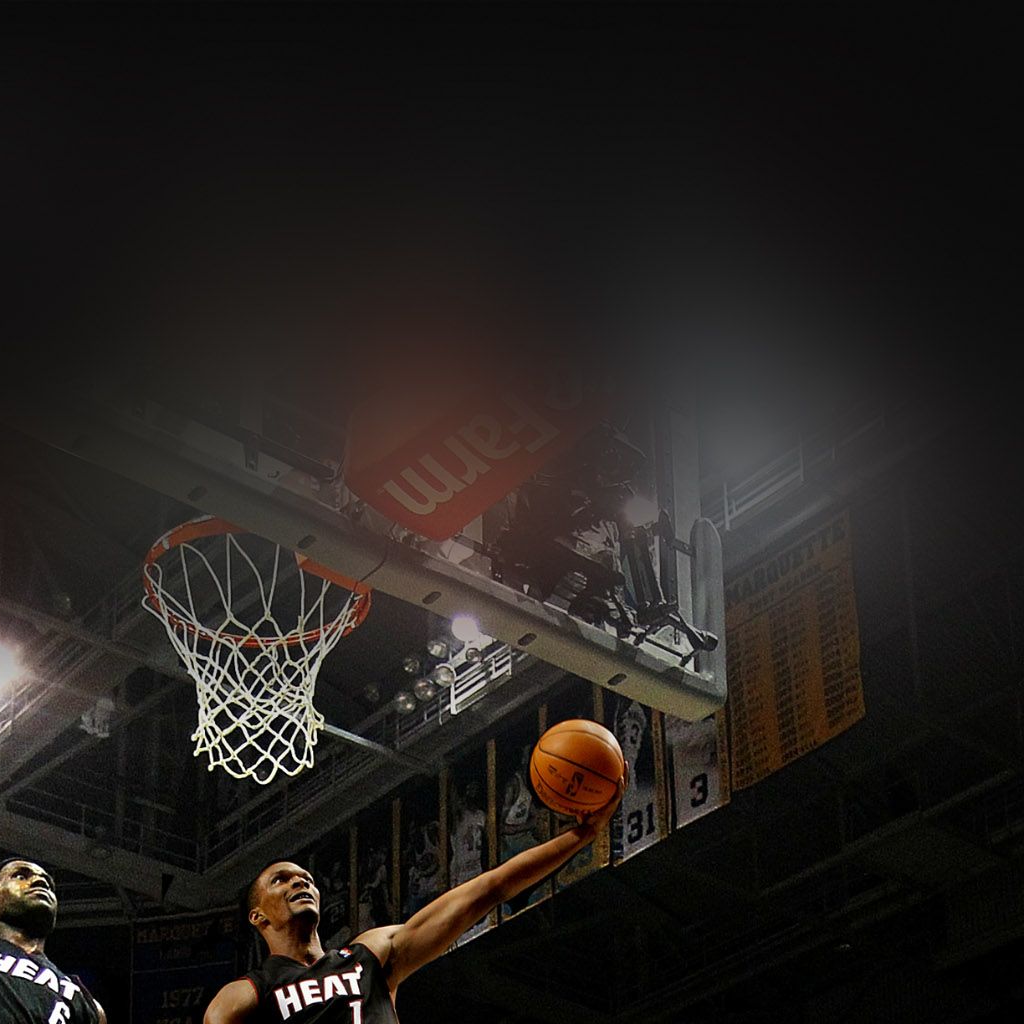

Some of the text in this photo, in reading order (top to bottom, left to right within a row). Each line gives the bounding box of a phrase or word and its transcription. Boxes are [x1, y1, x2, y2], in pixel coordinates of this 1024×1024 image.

[382, 394, 561, 516] Farm
[690, 774, 708, 807] 3
[627, 803, 657, 845] 31
[273, 961, 365, 1020] HEAT
